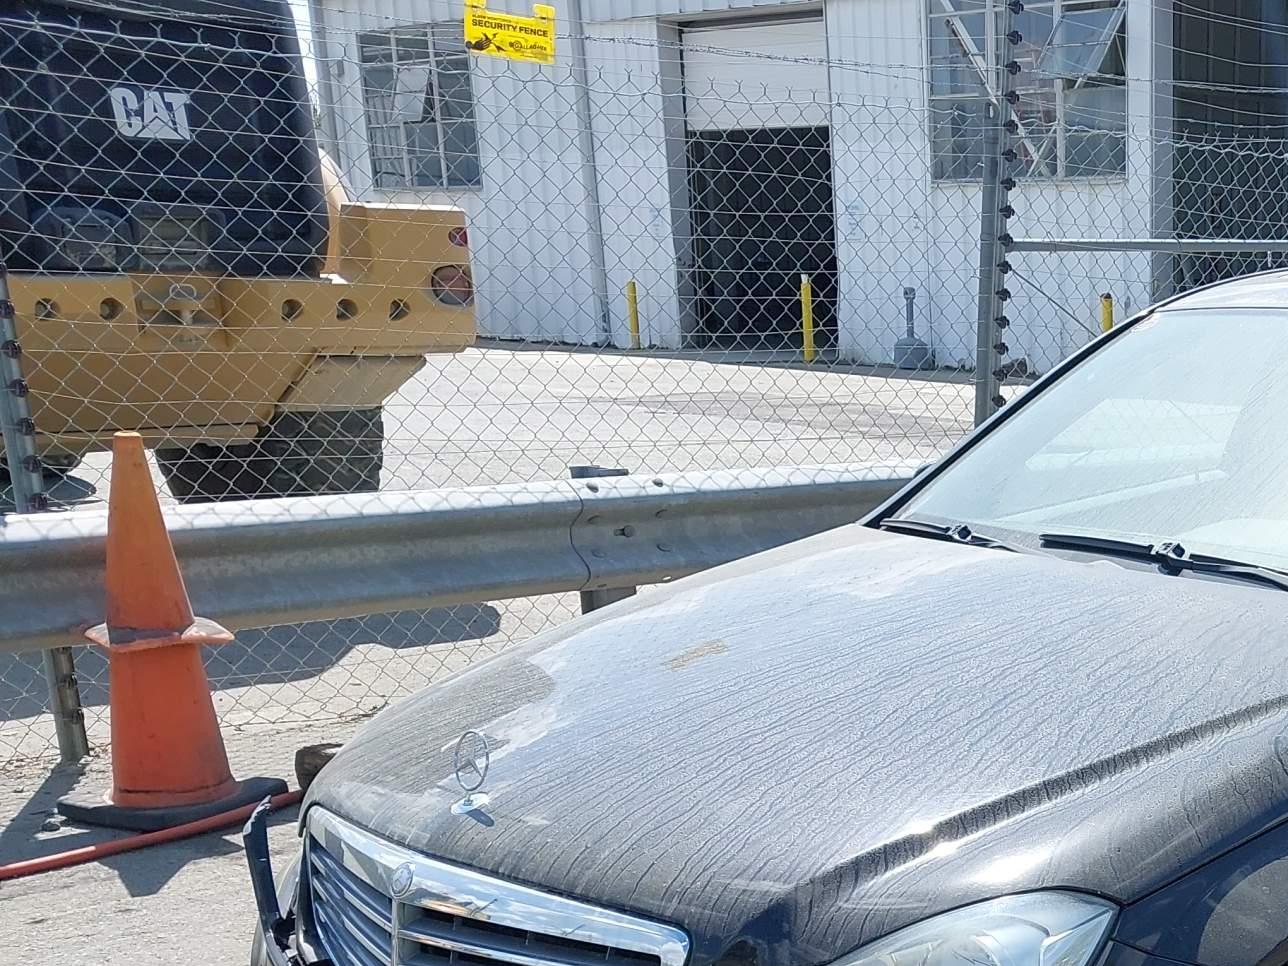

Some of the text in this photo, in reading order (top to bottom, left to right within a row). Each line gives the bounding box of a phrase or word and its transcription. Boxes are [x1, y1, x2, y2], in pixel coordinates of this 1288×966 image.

[472, 19, 549, 38] SECURITY FENCE
[111, 87, 191, 140] CAT
